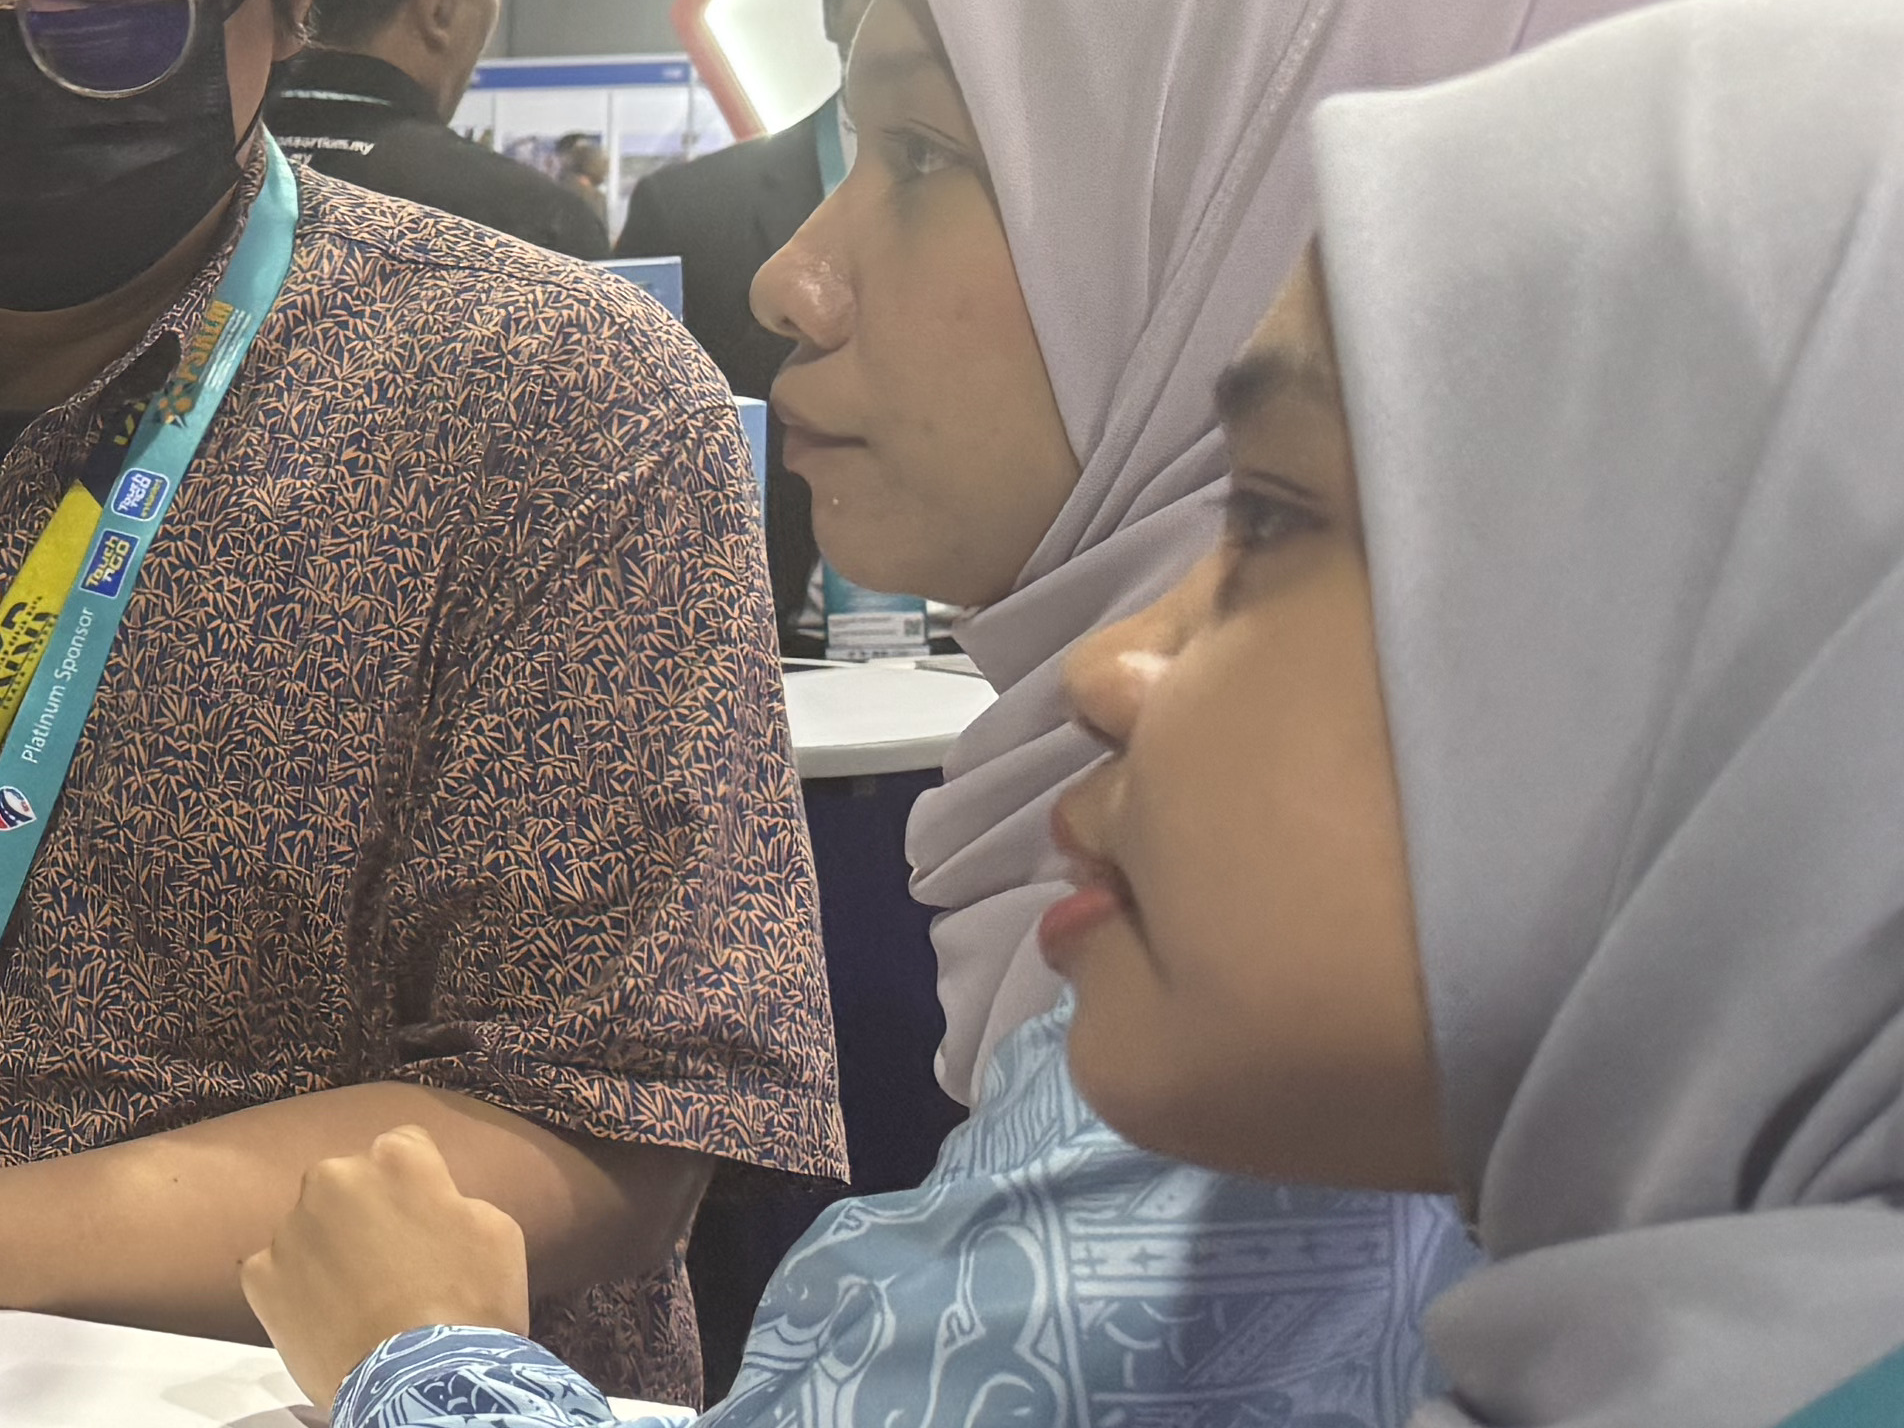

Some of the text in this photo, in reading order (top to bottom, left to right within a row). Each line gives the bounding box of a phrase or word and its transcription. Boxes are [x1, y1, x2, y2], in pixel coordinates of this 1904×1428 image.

[85, 535, 121, 587] Touch
[21, 607, 94, 764] Platinum Sponsor
